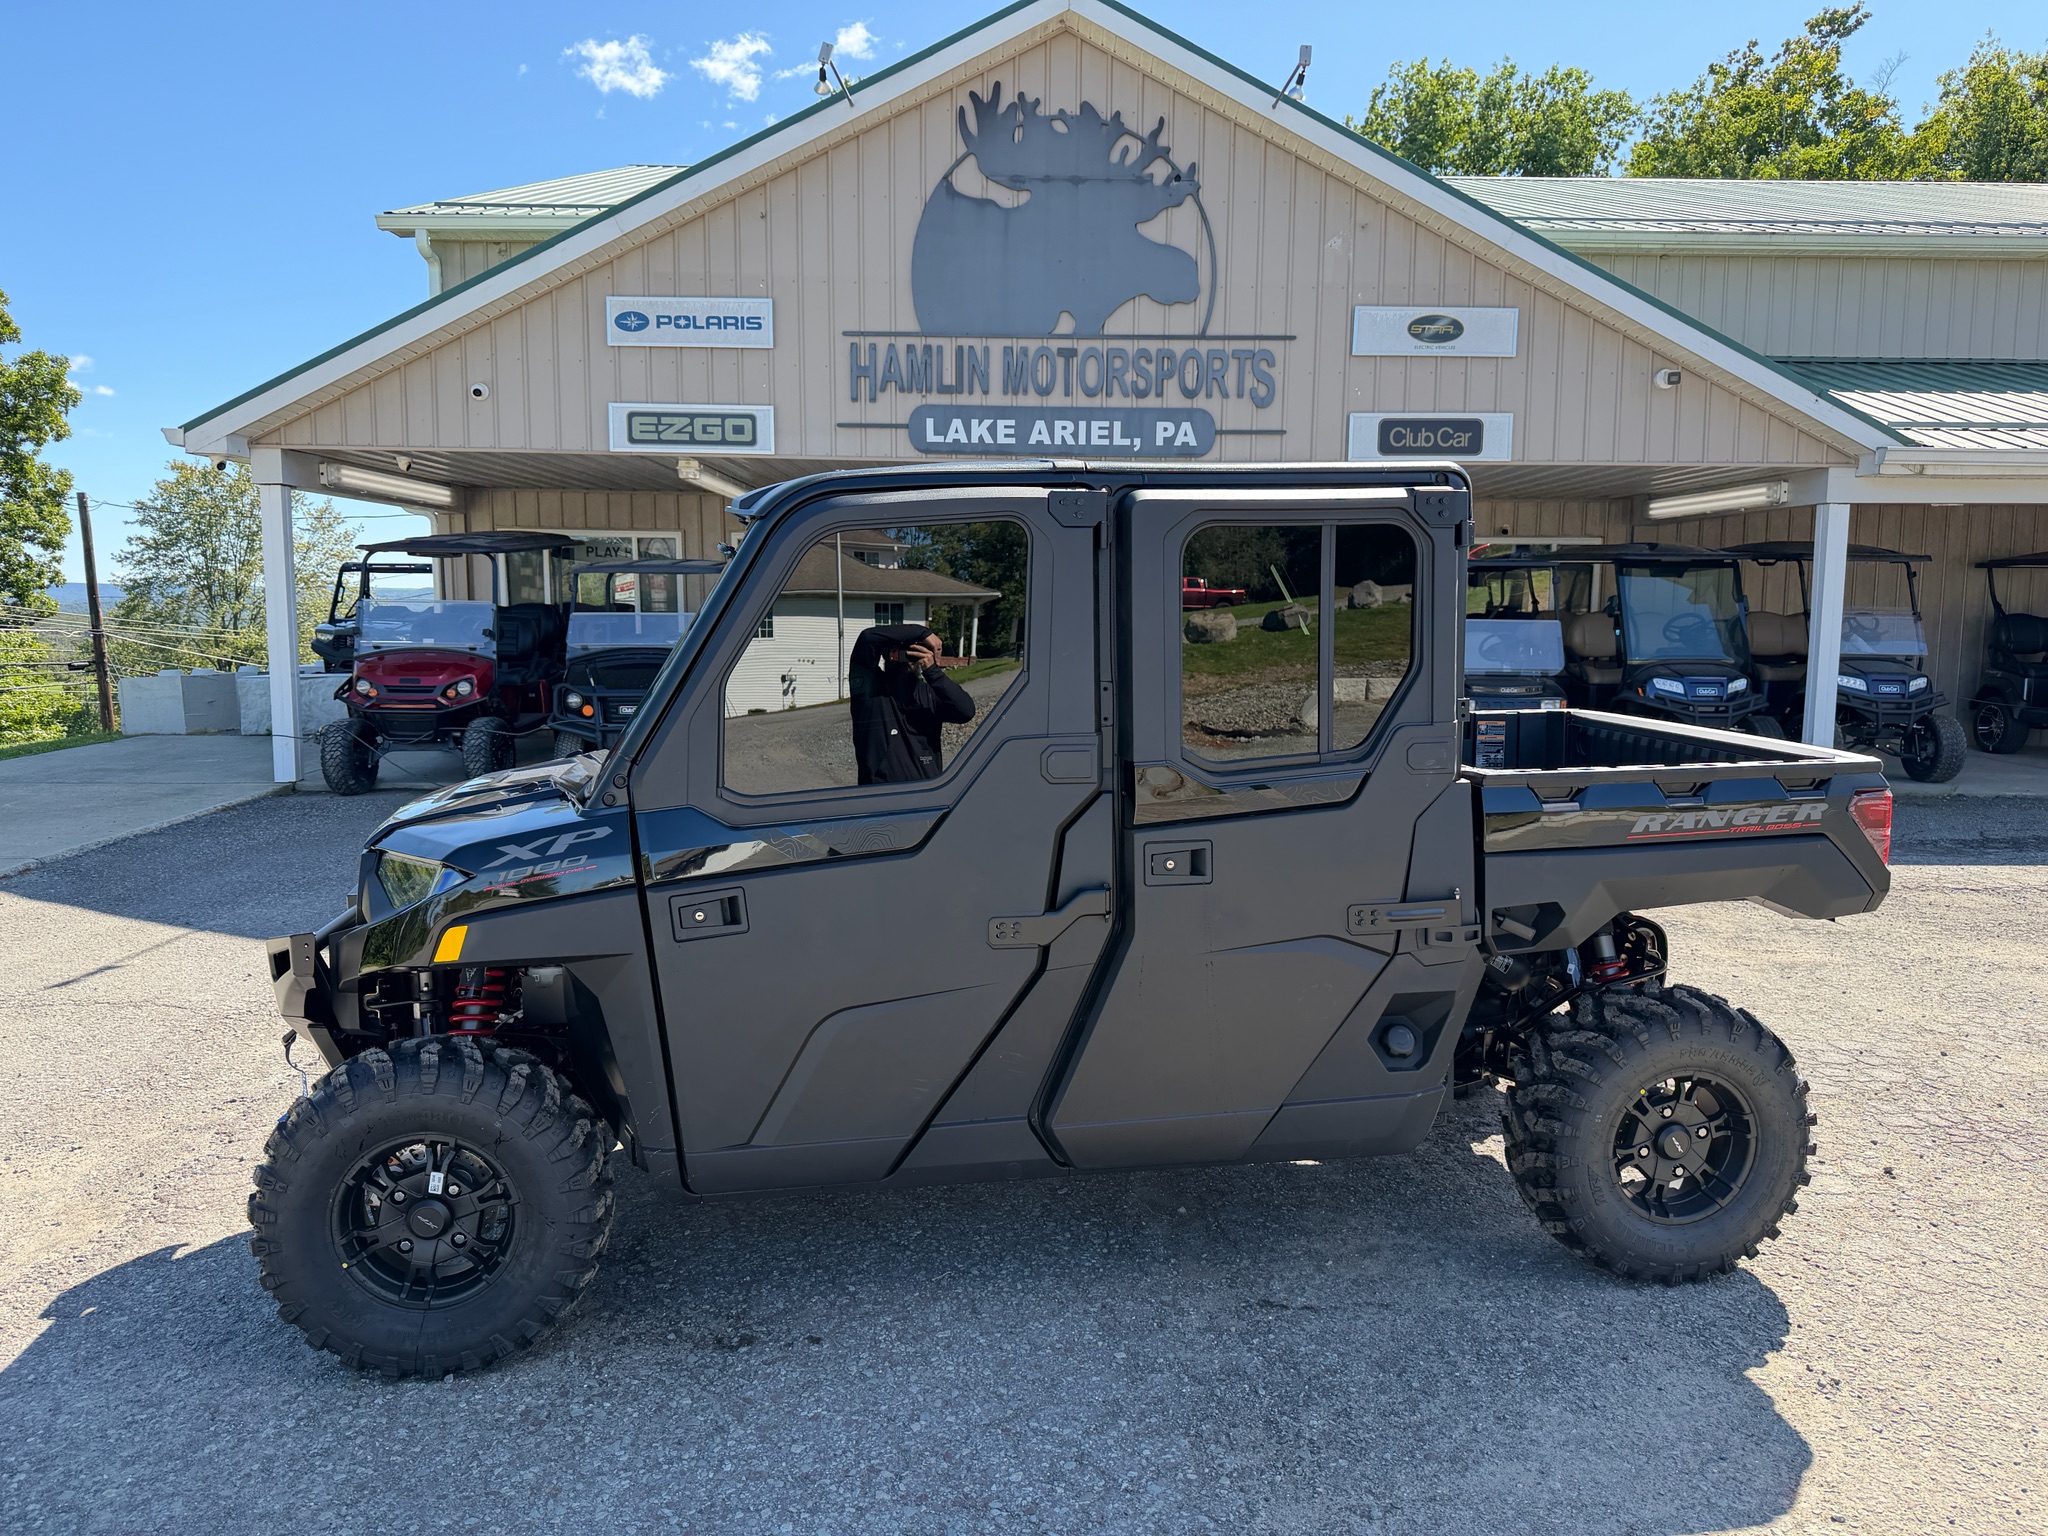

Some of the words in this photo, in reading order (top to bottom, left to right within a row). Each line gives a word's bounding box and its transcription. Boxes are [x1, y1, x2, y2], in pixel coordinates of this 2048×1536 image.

[656, 315, 763, 331] POLARIS
[1410, 325, 1454, 334] STAR
[850, 342, 989, 403] HAMLIN
[1003, 345, 1276, 409] MOTORSPORTS
[631, 416, 753, 442] EZGO
[926, 418, 1016, 444] LAKE
[1028, 420, 1142, 452] ARIEL,
[1156, 421, 1197, 447] PA
[1389, 427, 1434, 447] Club
[1437, 427, 1472, 447] Car
[586, 546, 619, 558] PLAY
[1631, 803, 1829, 833] RANGER
[1730, 825, 1764, 833] TRAIL
[1765, 822, 1802, 831] BOSS
[480, 826, 614, 870] XP
[498, 854, 588, 882] 1000
